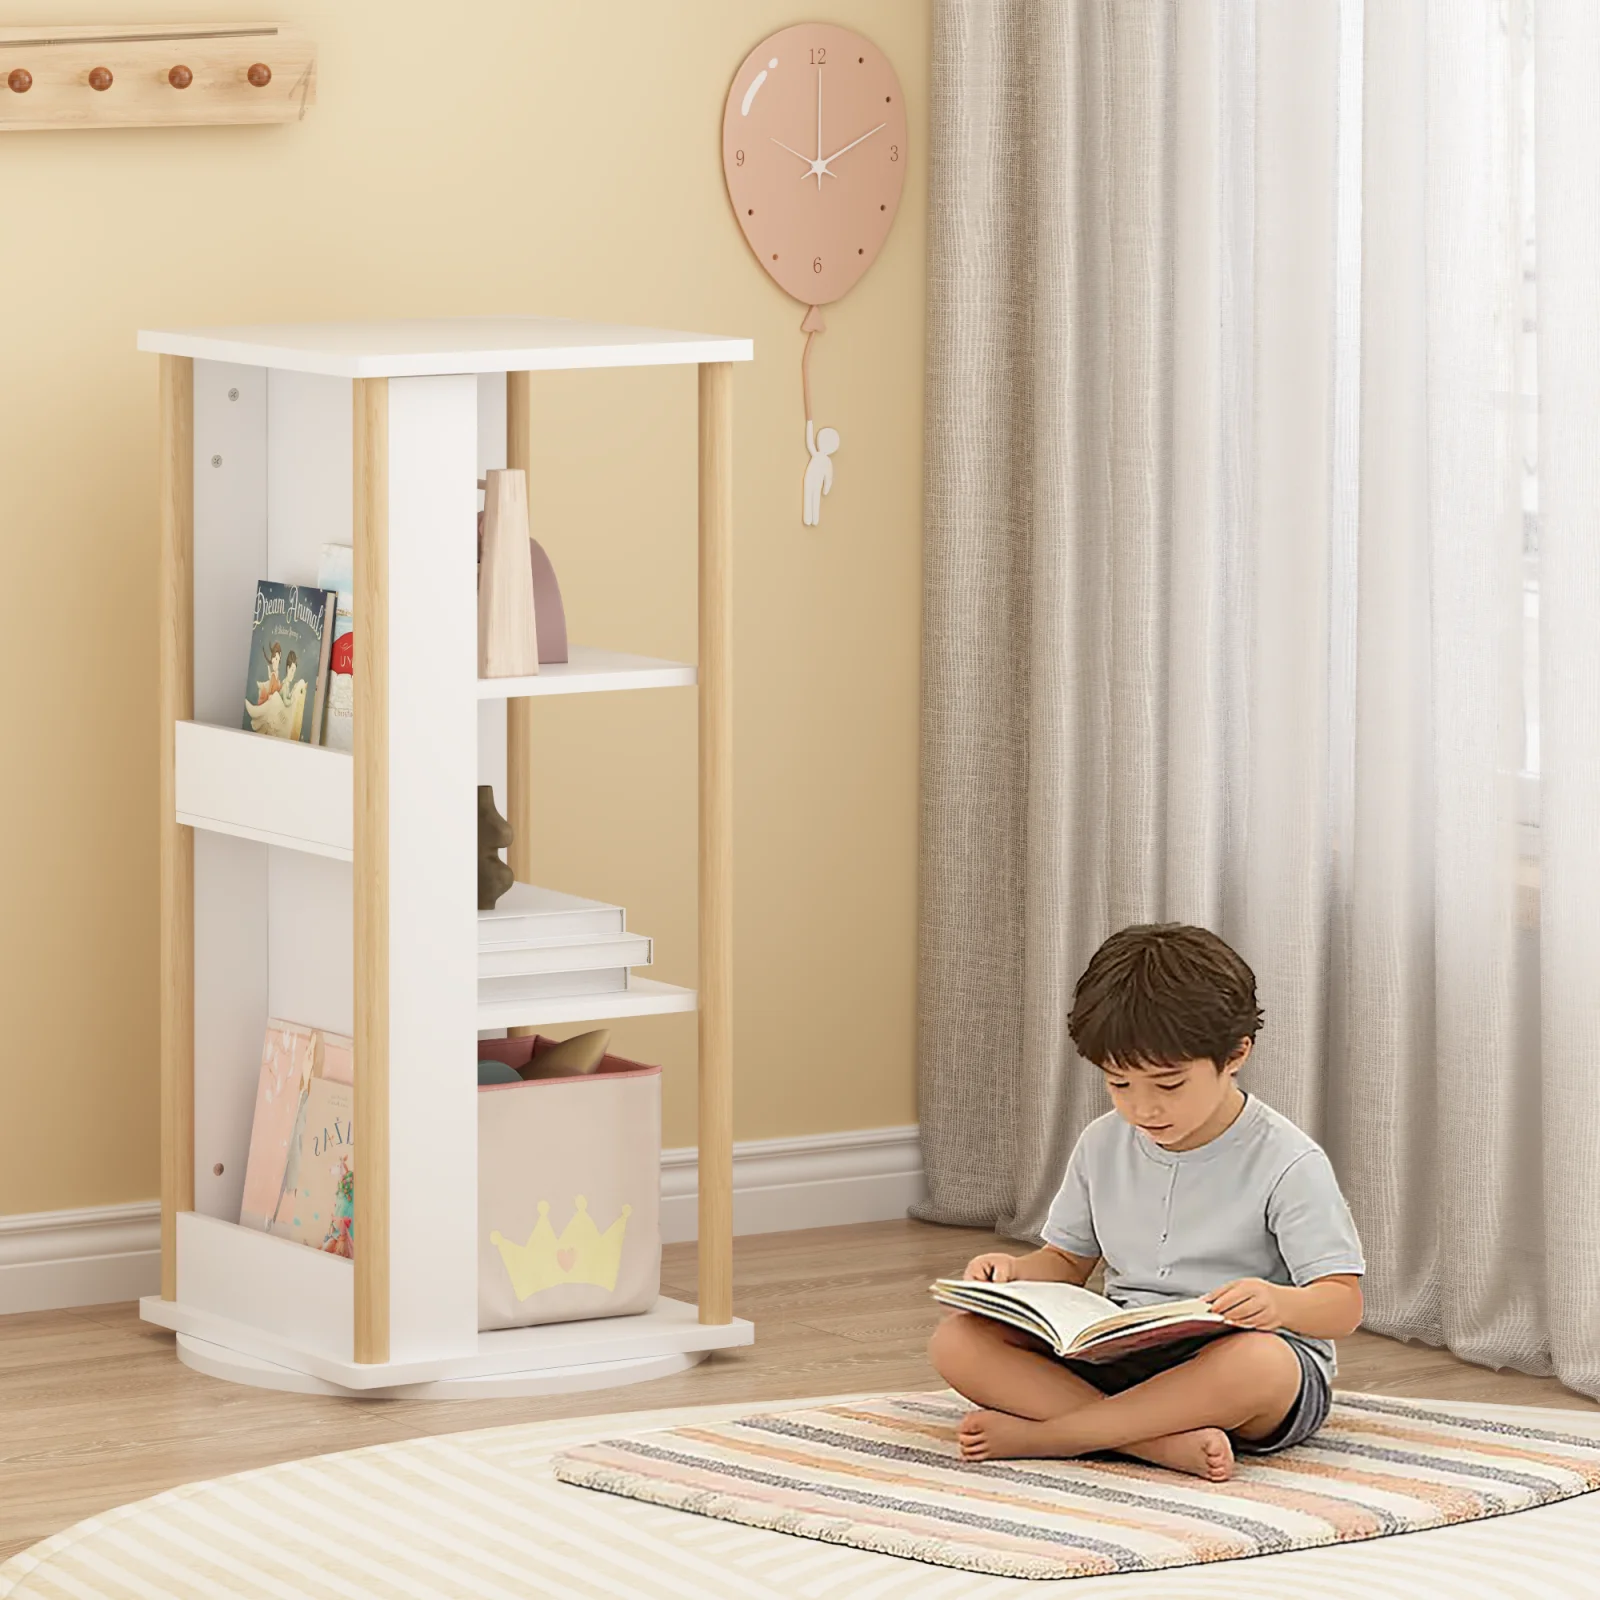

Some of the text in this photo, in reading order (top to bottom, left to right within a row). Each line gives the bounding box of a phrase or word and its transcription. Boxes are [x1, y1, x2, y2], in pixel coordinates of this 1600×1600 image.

[809, 47, 826, 65] 12
[735, 149, 745, 167] 9
[890, 144, 899, 162] 3
[813, 256, 822, 274] 6
[252, 584, 324, 640] Dream Animals
